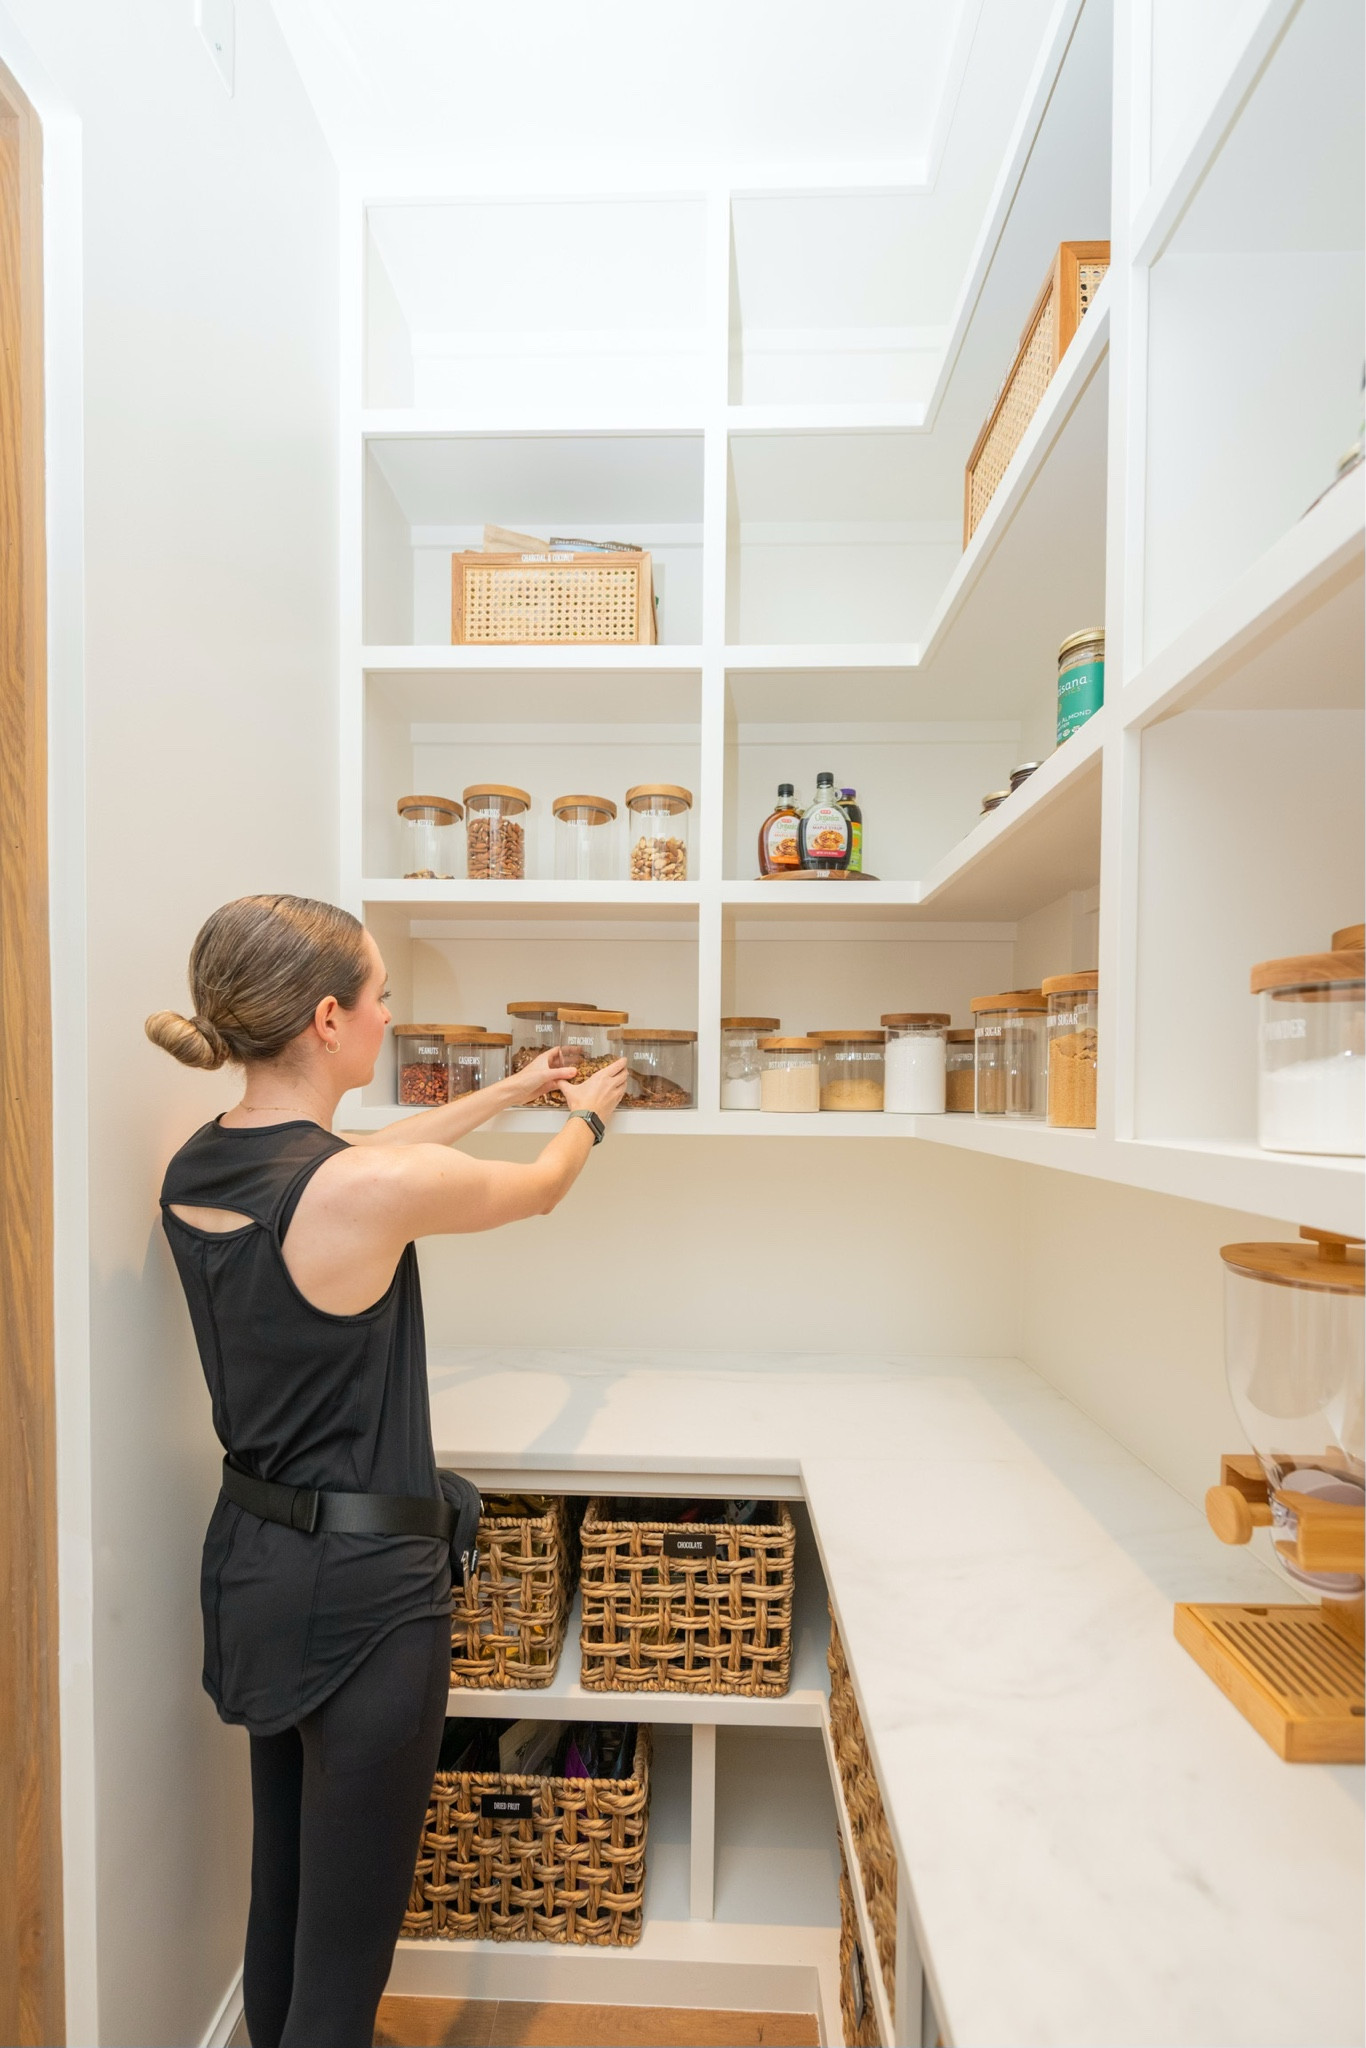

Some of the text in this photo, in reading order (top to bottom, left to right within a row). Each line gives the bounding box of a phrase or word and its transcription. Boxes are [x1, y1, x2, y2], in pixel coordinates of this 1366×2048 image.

[1058, 676, 1087, 695] isana
[1062, 709, 1091, 722] ALMOND
[1057, 1012, 1078, 1026] SUGAR
[535, 1024, 553, 1033] PECANS
[984, 1026, 1002, 1037] SUGAR
[567, 1036, 594, 1046] PISTACHIOS
[418, 1046, 439, 1055] PEANUTS
[458, 1056, 481, 1065] CASHEWS
[676, 1541, 703, 1549] CHOCOLATE
[493, 1801, 520, 1811] DRIED FRUIT
